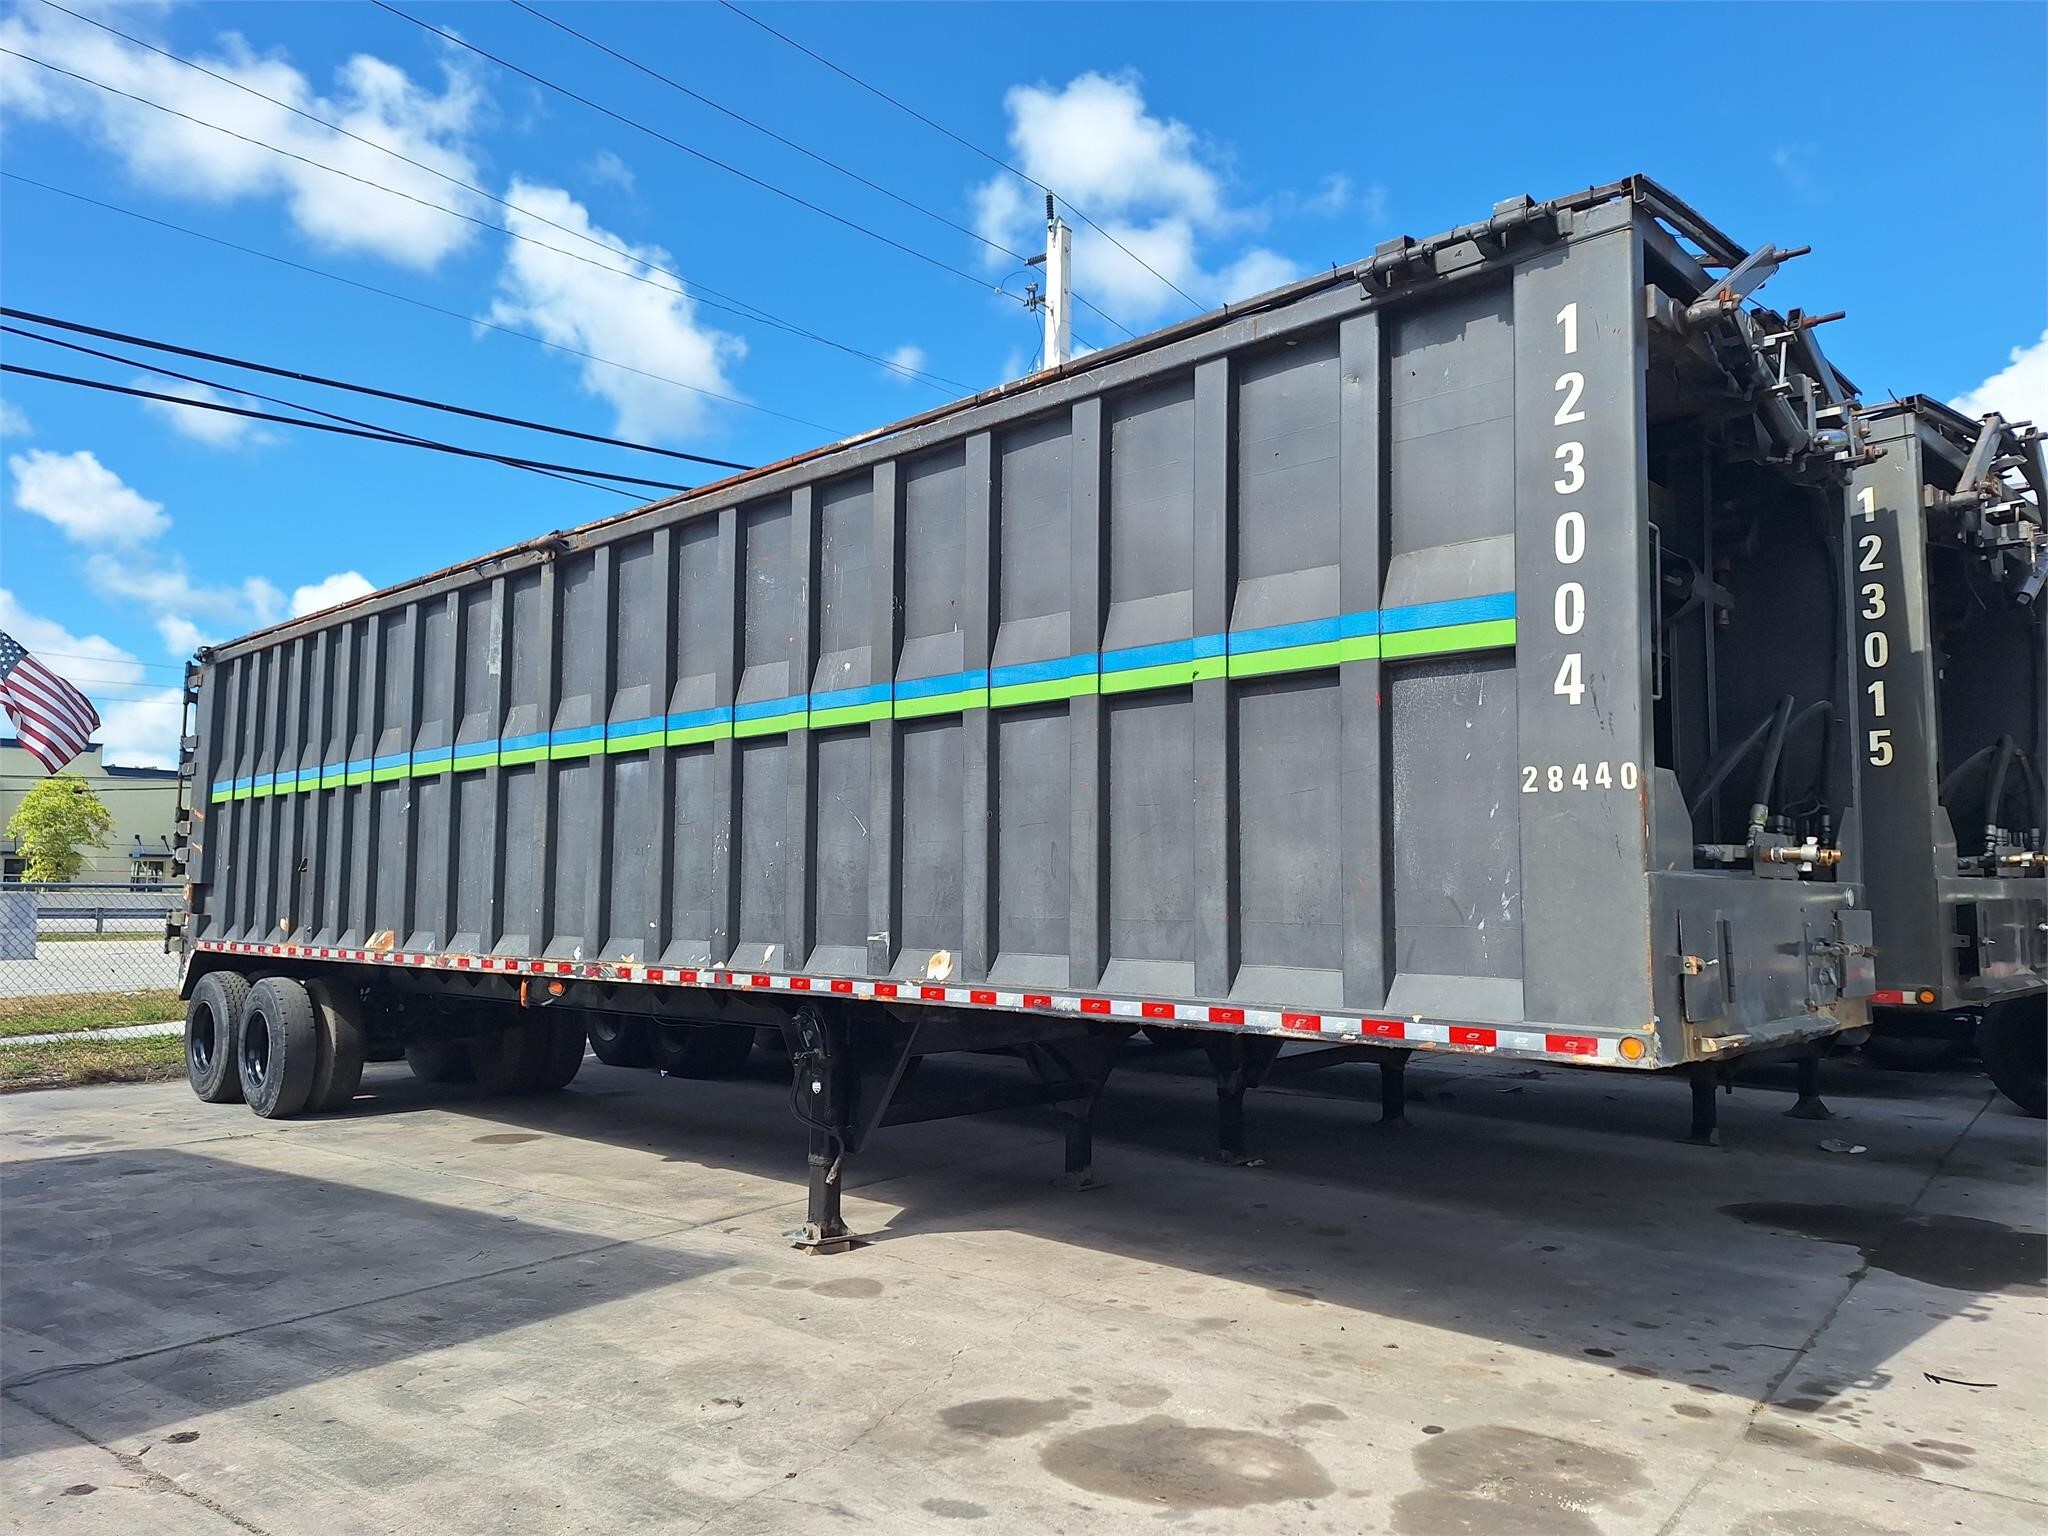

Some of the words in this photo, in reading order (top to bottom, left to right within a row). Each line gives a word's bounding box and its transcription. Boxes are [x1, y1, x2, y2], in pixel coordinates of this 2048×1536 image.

[1553, 302, 1587, 705] 123004
[1856, 486, 1894, 767] 123015
[1521, 761, 1639, 794] 28440
